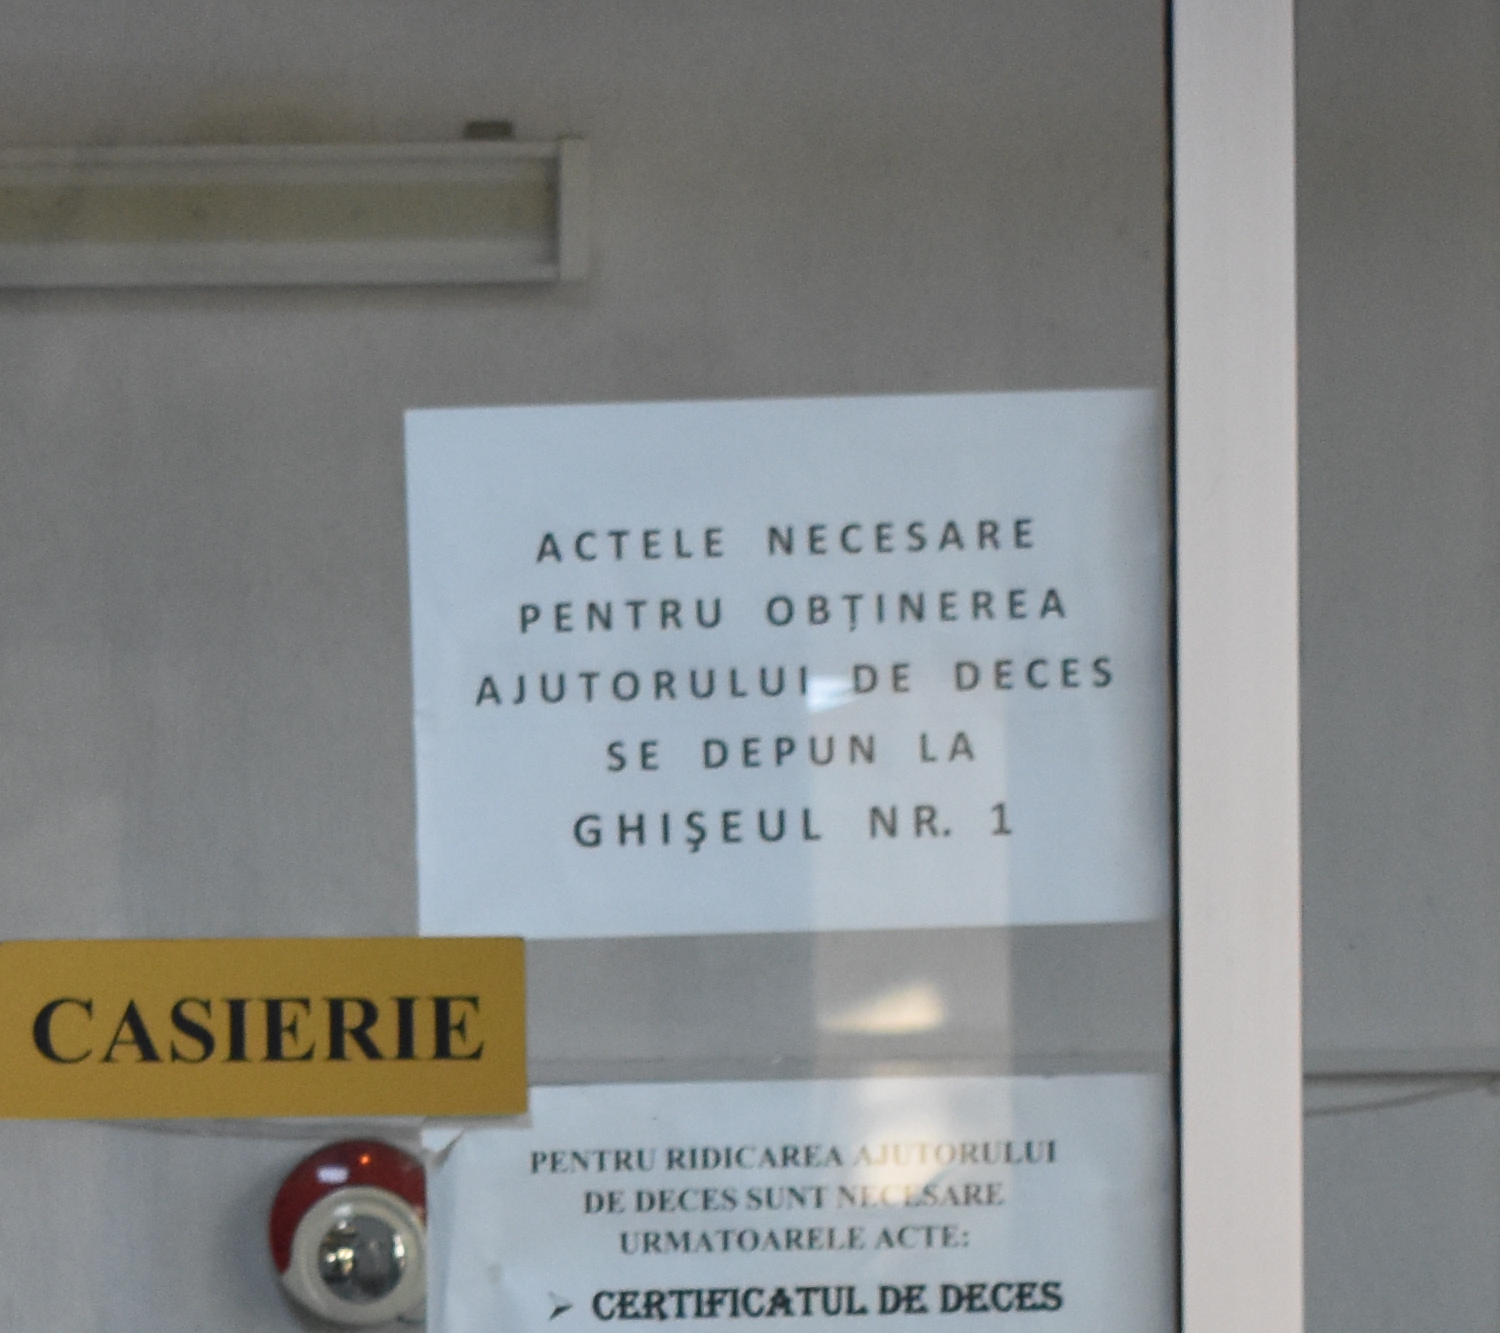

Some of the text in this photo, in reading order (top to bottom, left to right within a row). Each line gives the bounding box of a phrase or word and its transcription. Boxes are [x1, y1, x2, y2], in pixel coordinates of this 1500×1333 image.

[537, 519, 1032, 562] ACTELE NECESARE
[520, 598, 721, 633] PENTRU
[476, 657, 1112, 710] AJUTORULUI DE DECES
[608, 731, 974, 772] SE DEPUN LA
[870, 805, 950, 838] NR.
[992, 803, 1012, 835] 1
[33, 996, 482, 1063] CASIERIE
[530, 1149, 654, 1173] PENTRU
[667, 1145, 844, 1170] RIDICAREA
[583, 1182, 1005, 1213] DE DECES SUNT NECESARE
[621, 1226, 967, 1253] URMATOARELE ACTE:
[592, 1281, 1063, 1321] CERTIFICATUL DE DECES
